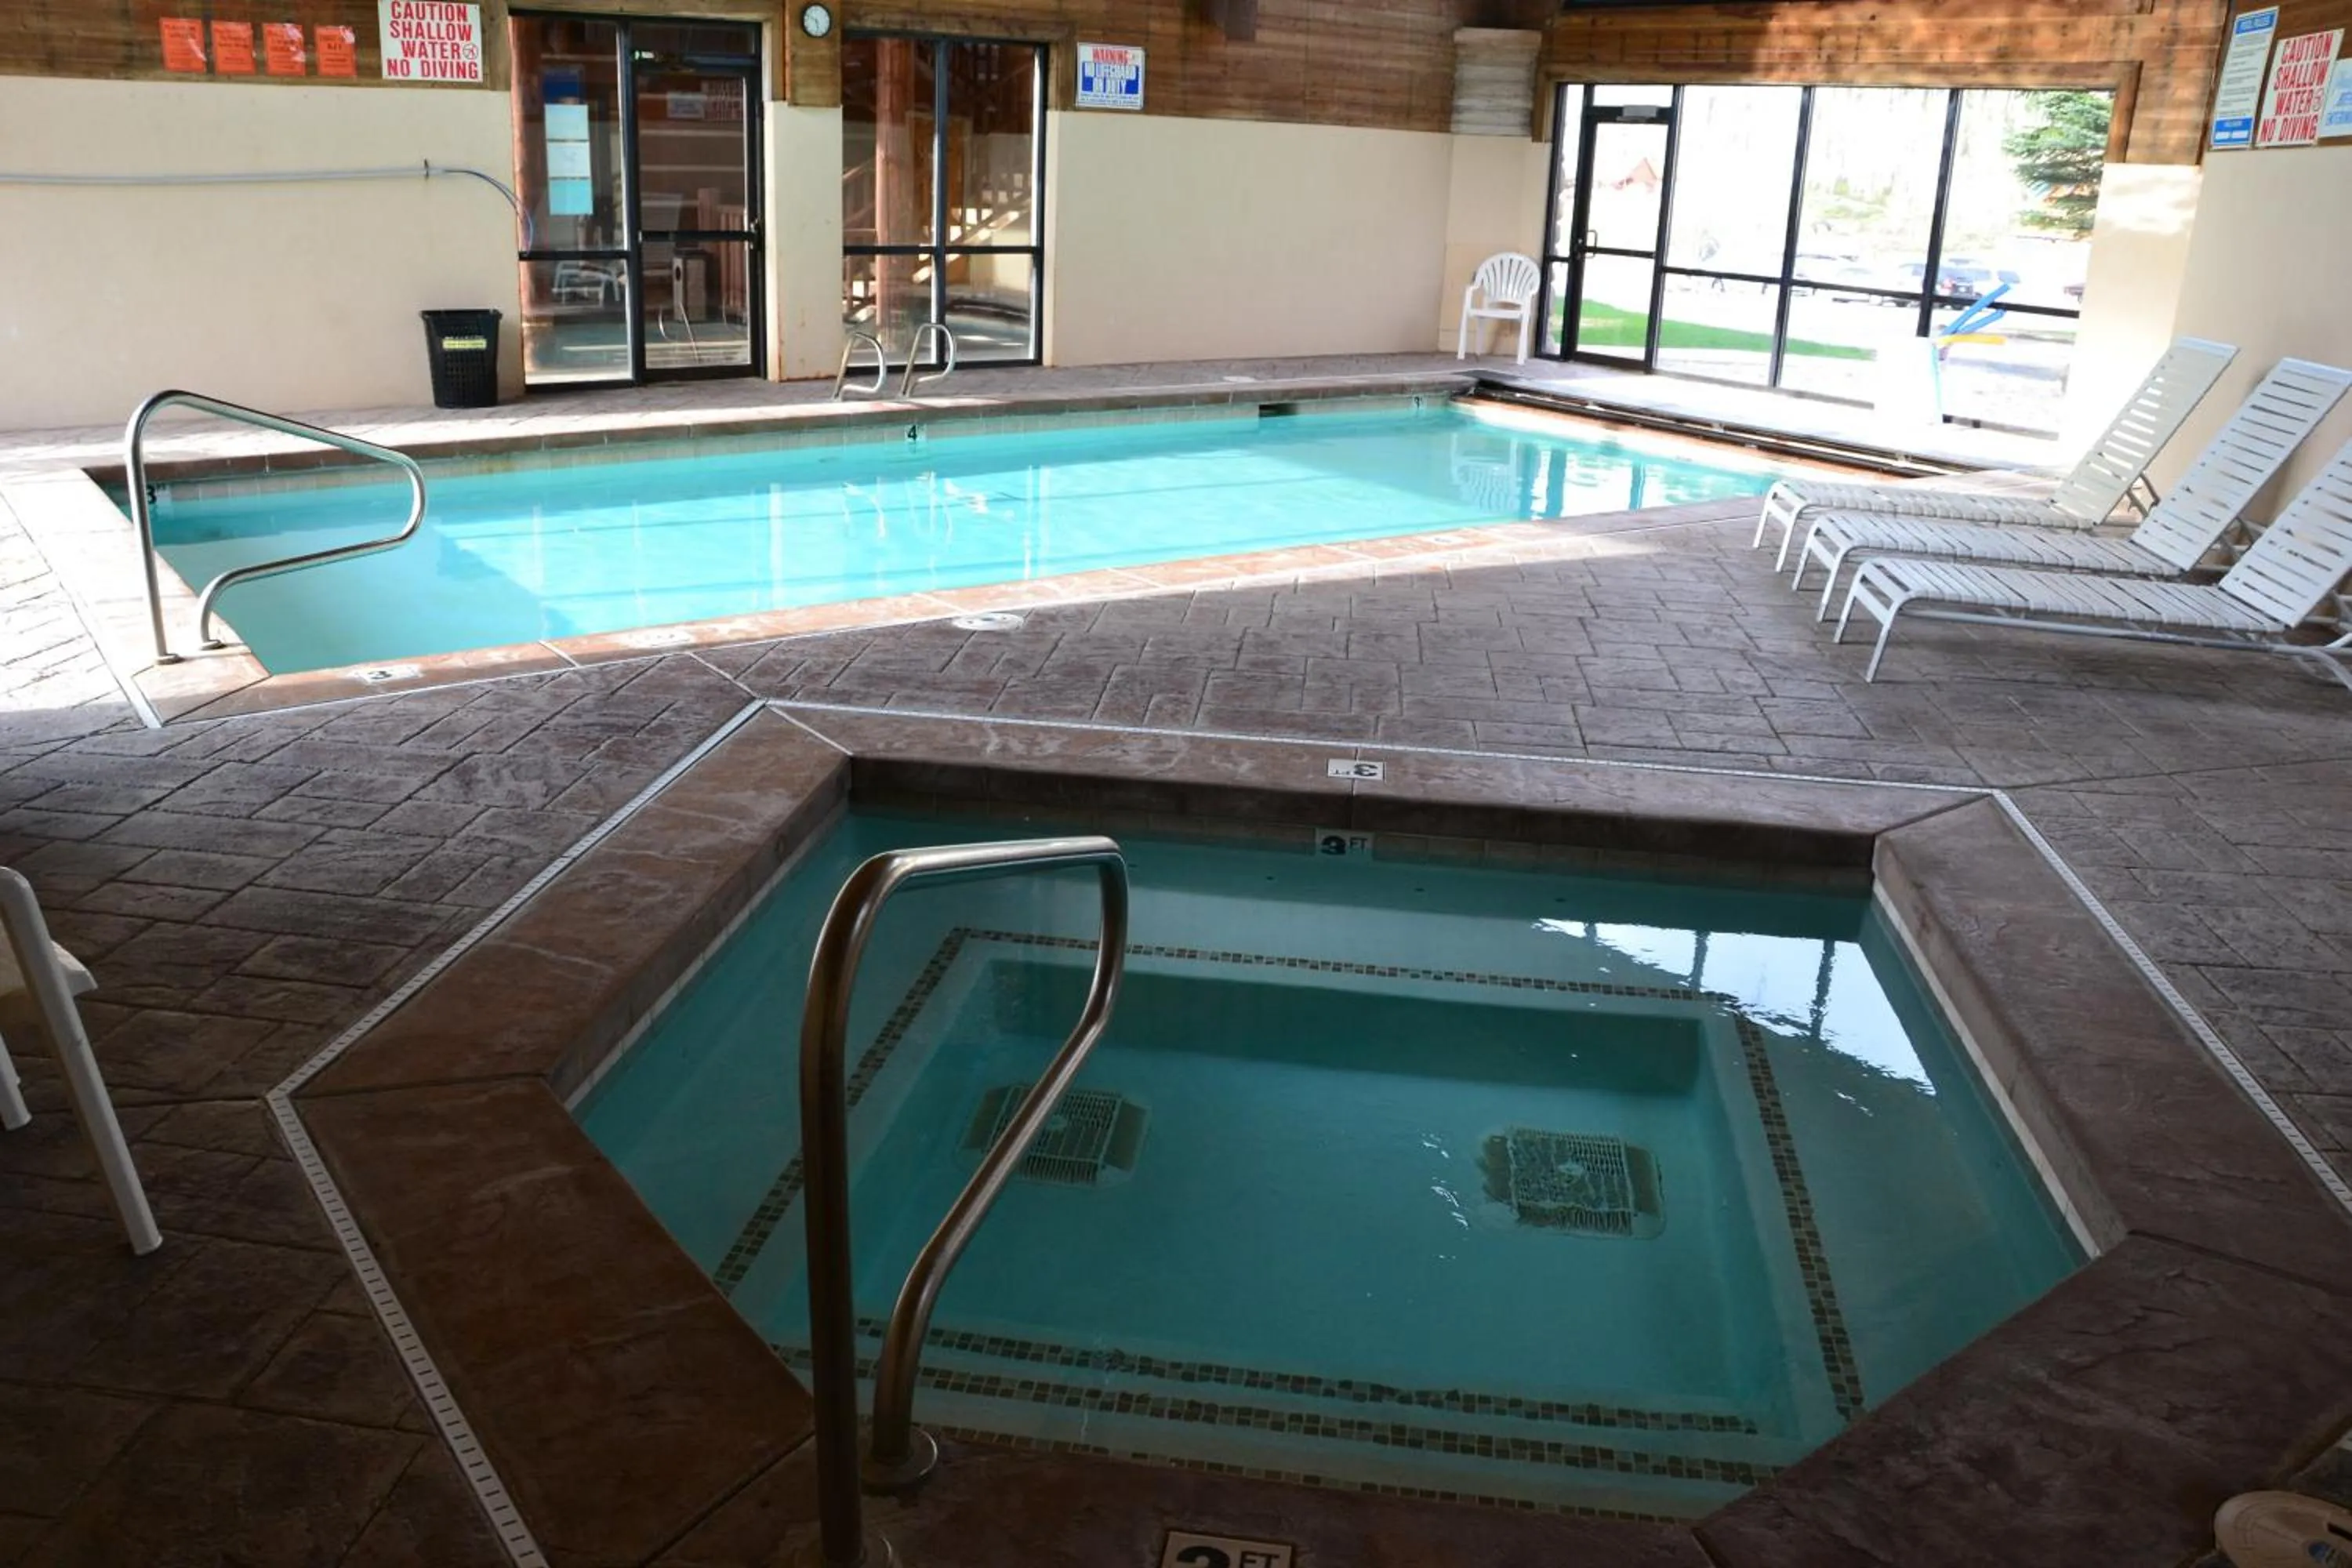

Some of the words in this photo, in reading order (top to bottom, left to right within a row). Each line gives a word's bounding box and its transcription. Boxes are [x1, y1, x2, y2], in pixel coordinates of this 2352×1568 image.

[390, 1, 468, 22] CAUTION
[390, 20, 472, 42] SHALLOW
[401, 40, 461, 60] WATER
[2282, 32, 2334, 64] CAUTION
[387, 57, 410, 77] NO
[420, 60, 478, 79] DIVING
[2274, 60, 2331, 91] SHALLOW
[2275, 89, 2314, 116] WATER
[2259, 118, 2276, 142] NO
[2278, 114, 2318, 142] DIVING
[907, 424, 917, 441] 4
[147, 484, 157, 505] 3
[1320, 835, 1346, 855] 3
